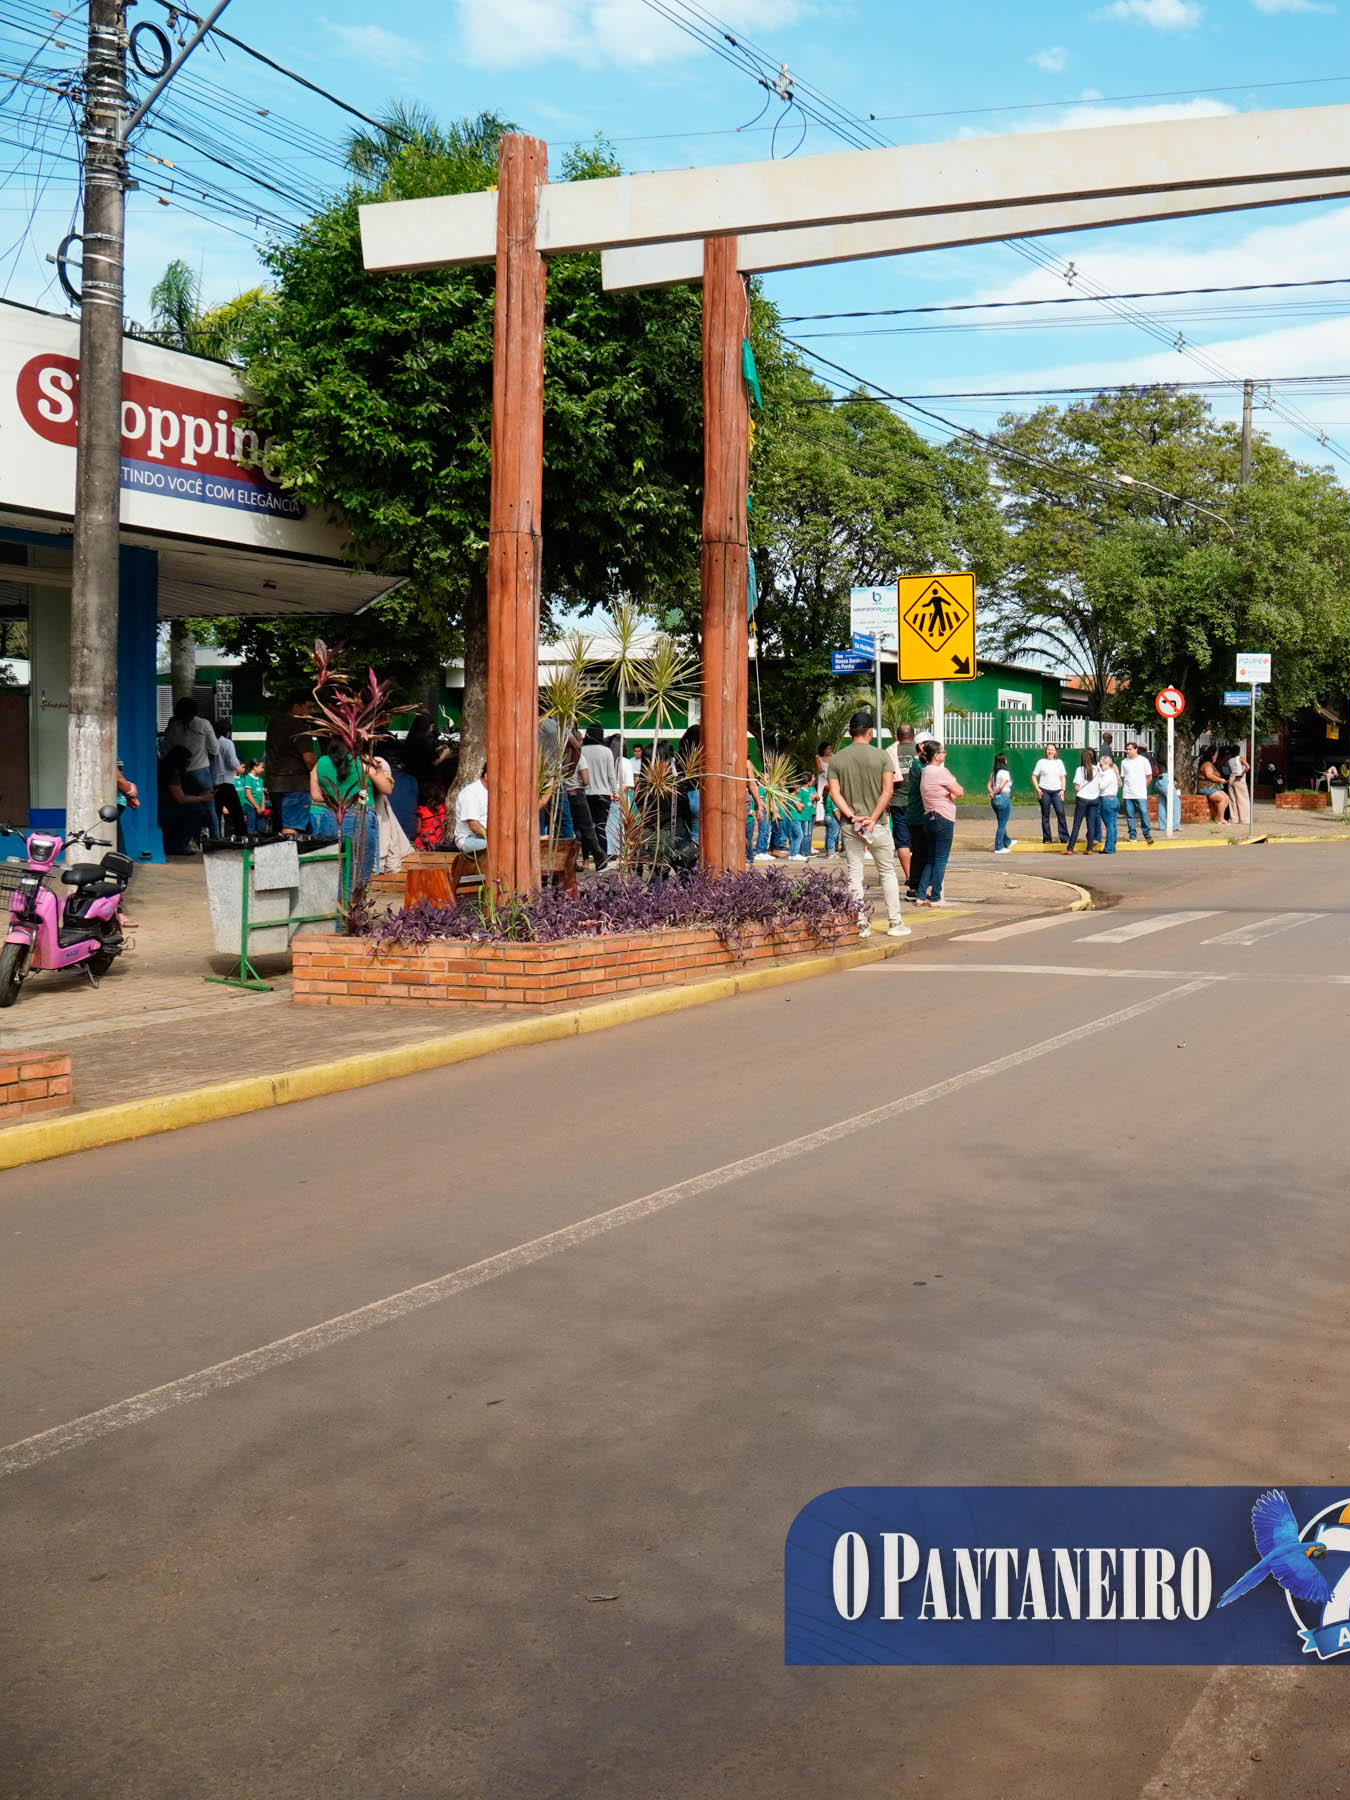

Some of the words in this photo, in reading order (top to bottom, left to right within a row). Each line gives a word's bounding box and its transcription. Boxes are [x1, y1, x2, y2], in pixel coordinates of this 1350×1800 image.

[121, 466, 165, 486] TINDO
[167, 476, 203, 496] VOCÊ
[205, 483, 235, 502] COM
[237, 489, 300, 514] ELEGÂNCIA
